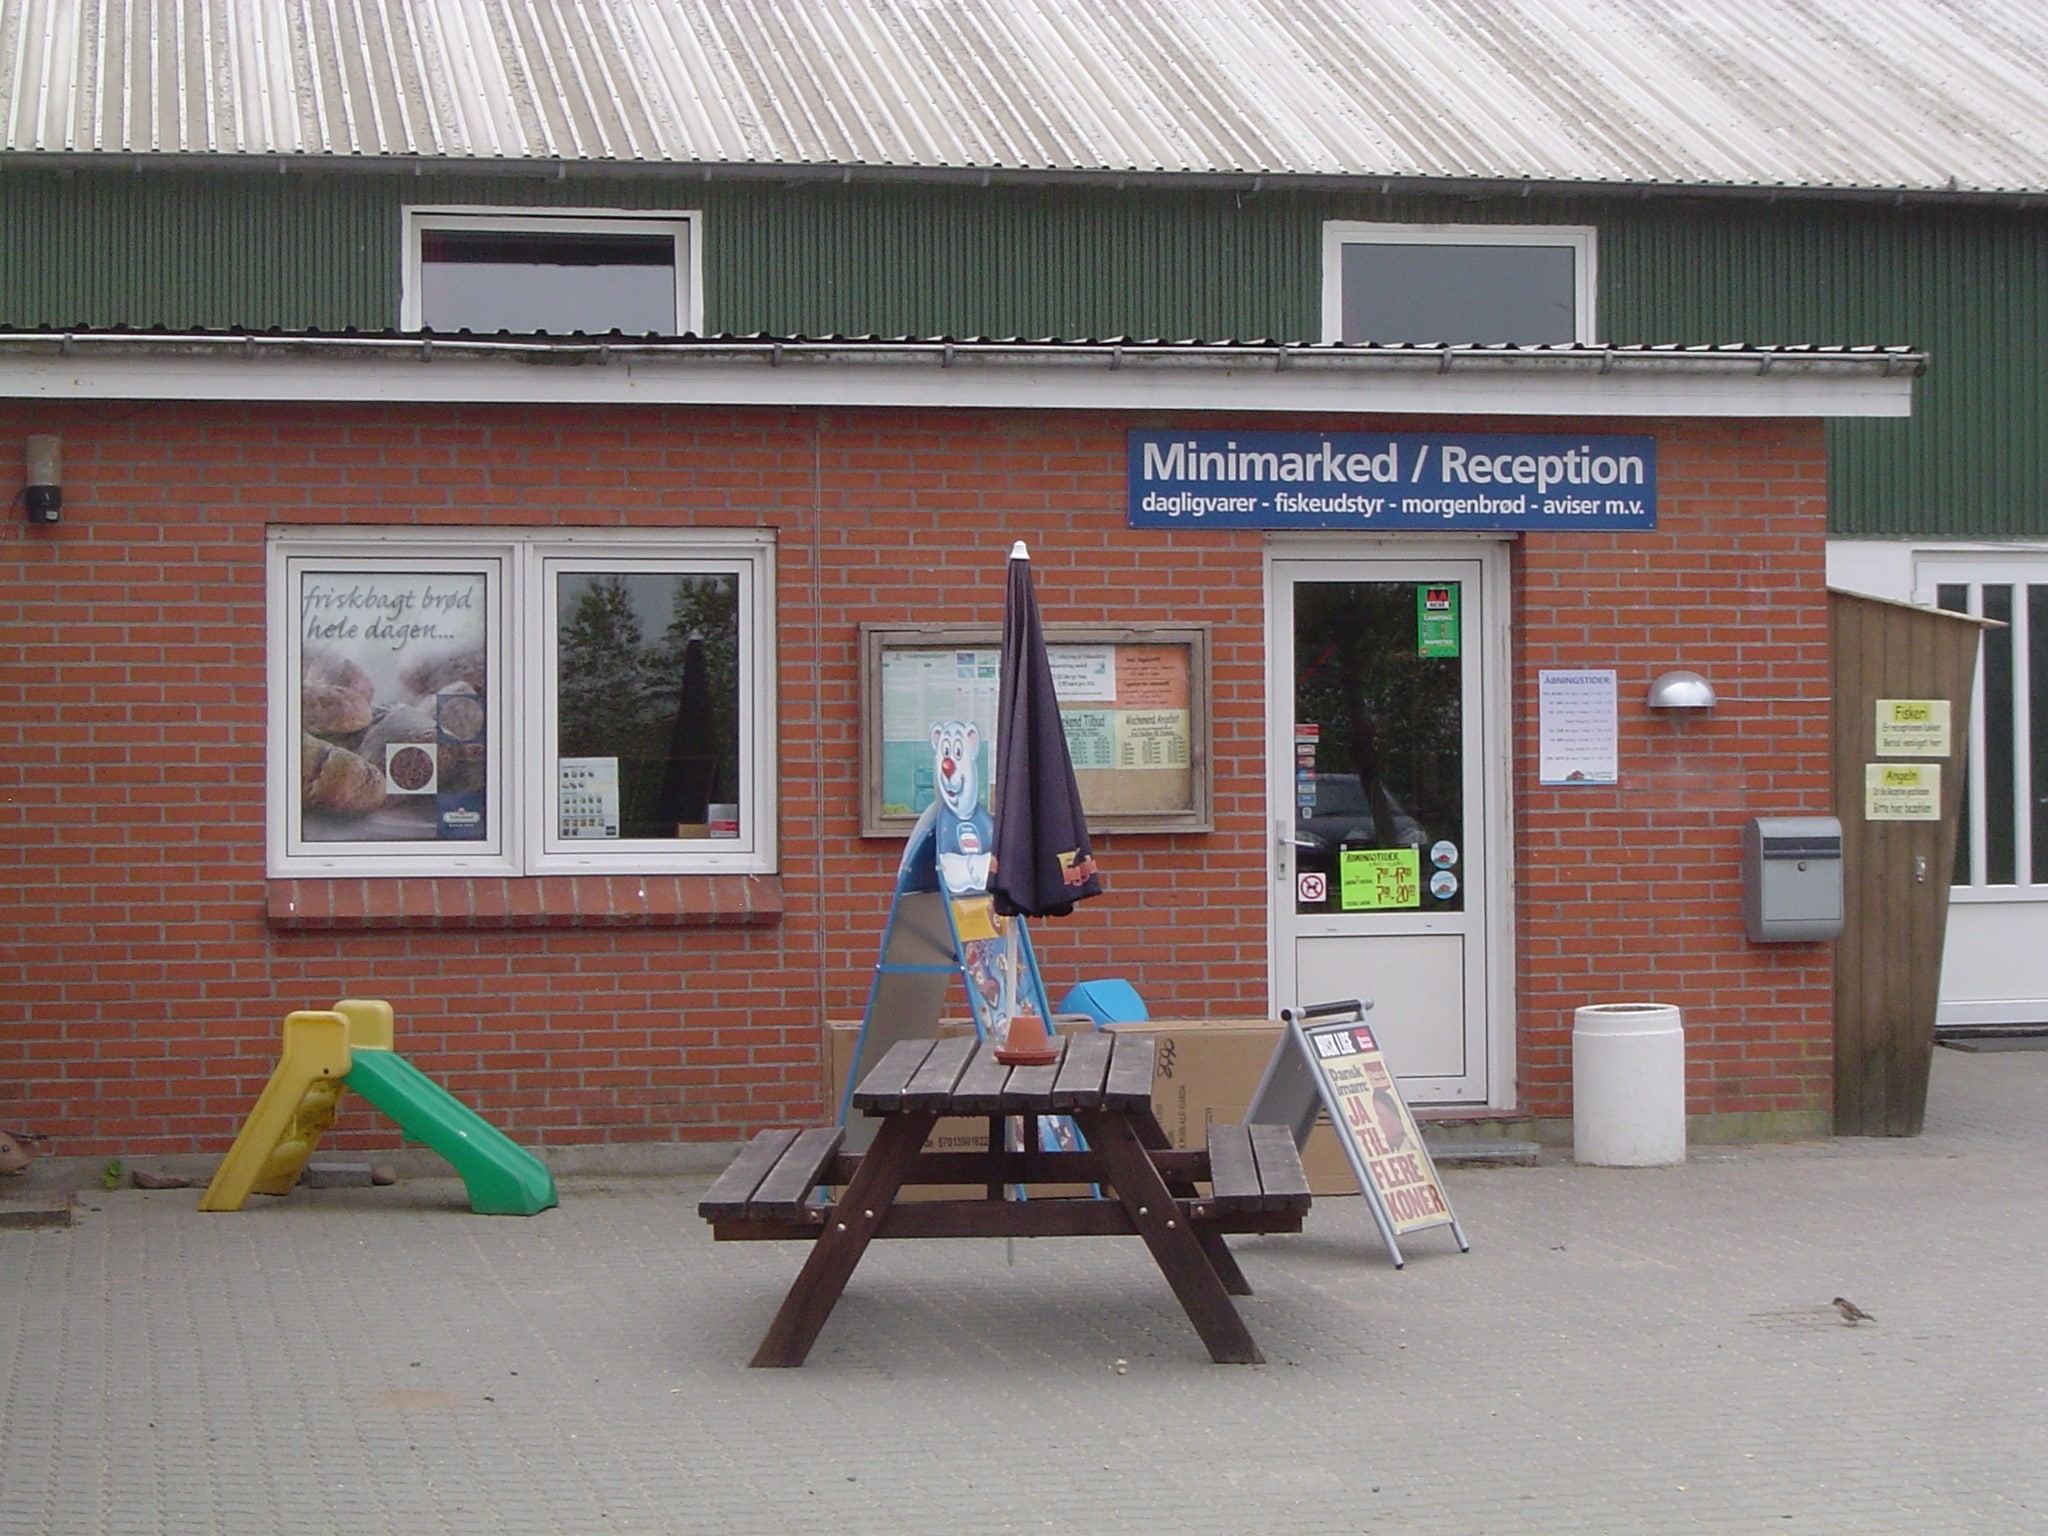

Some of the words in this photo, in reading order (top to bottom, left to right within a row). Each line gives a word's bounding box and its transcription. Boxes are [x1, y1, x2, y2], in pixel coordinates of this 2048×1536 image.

[1142, 441, 1399, 484] Minimarked
[1411, 445, 1429, 483] /
[1441, 445, 1645, 493] Reception
[1141, 493, 1258, 516] dagligvarer
[1274, 495, 1385, 517] fiskeudstyr
[1402, 496, 1527, 517] morgenbrød
[1543, 498, 1602, 515] aviser
[1606, 499, 1645, 515] m.v.
[302, 585, 416, 620] friskbagt
[421, 585, 473, 614] brød
[306, 615, 358, 640] hele
[364, 615, 455, 651] dagen...
[1328, 1065, 1363, 1081] Dansk
[1348, 1096, 1371, 1126] JA
[1356, 1128, 1390, 1157] TIL
[1368, 1153, 1425, 1190] FLERE
[1383, 1184, 1446, 1223] KONER
